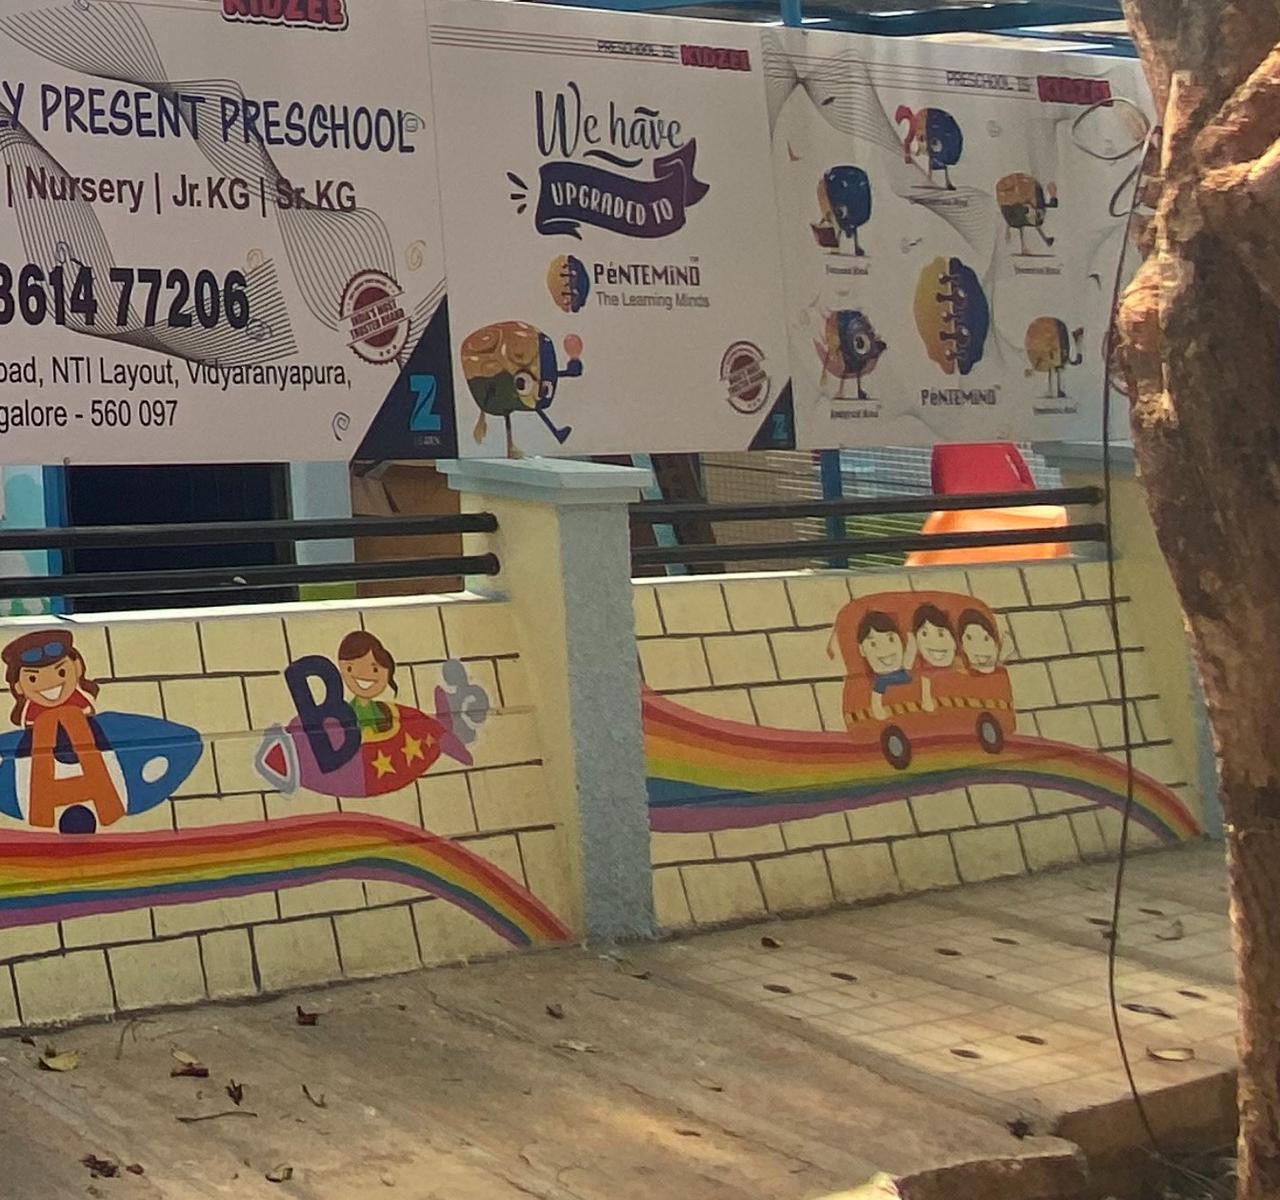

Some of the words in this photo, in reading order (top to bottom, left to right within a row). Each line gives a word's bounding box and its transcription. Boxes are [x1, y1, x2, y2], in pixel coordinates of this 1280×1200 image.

[41, 85, 206, 139] PRESENT
[220, 96, 415, 152] PRESCHOOL
[535, 81, 601, 158] We
[609, 100, 685, 150] have
[25, 166, 144, 213] Nursery
[550, 182, 646, 226] UPGRADED
[652, 198, 674, 225] TO
[109, 267, 250, 329] 77206
[596, 291, 619, 306] The
[621, 292, 672, 310] Learning
[52, 356, 91, 385] NTI
[99, 356, 179, 391] Layout,
[187, 358, 352, 392] Vidyaranyapura,
[91, 399, 131, 427] 560
[139, 399, 178, 427] 097
